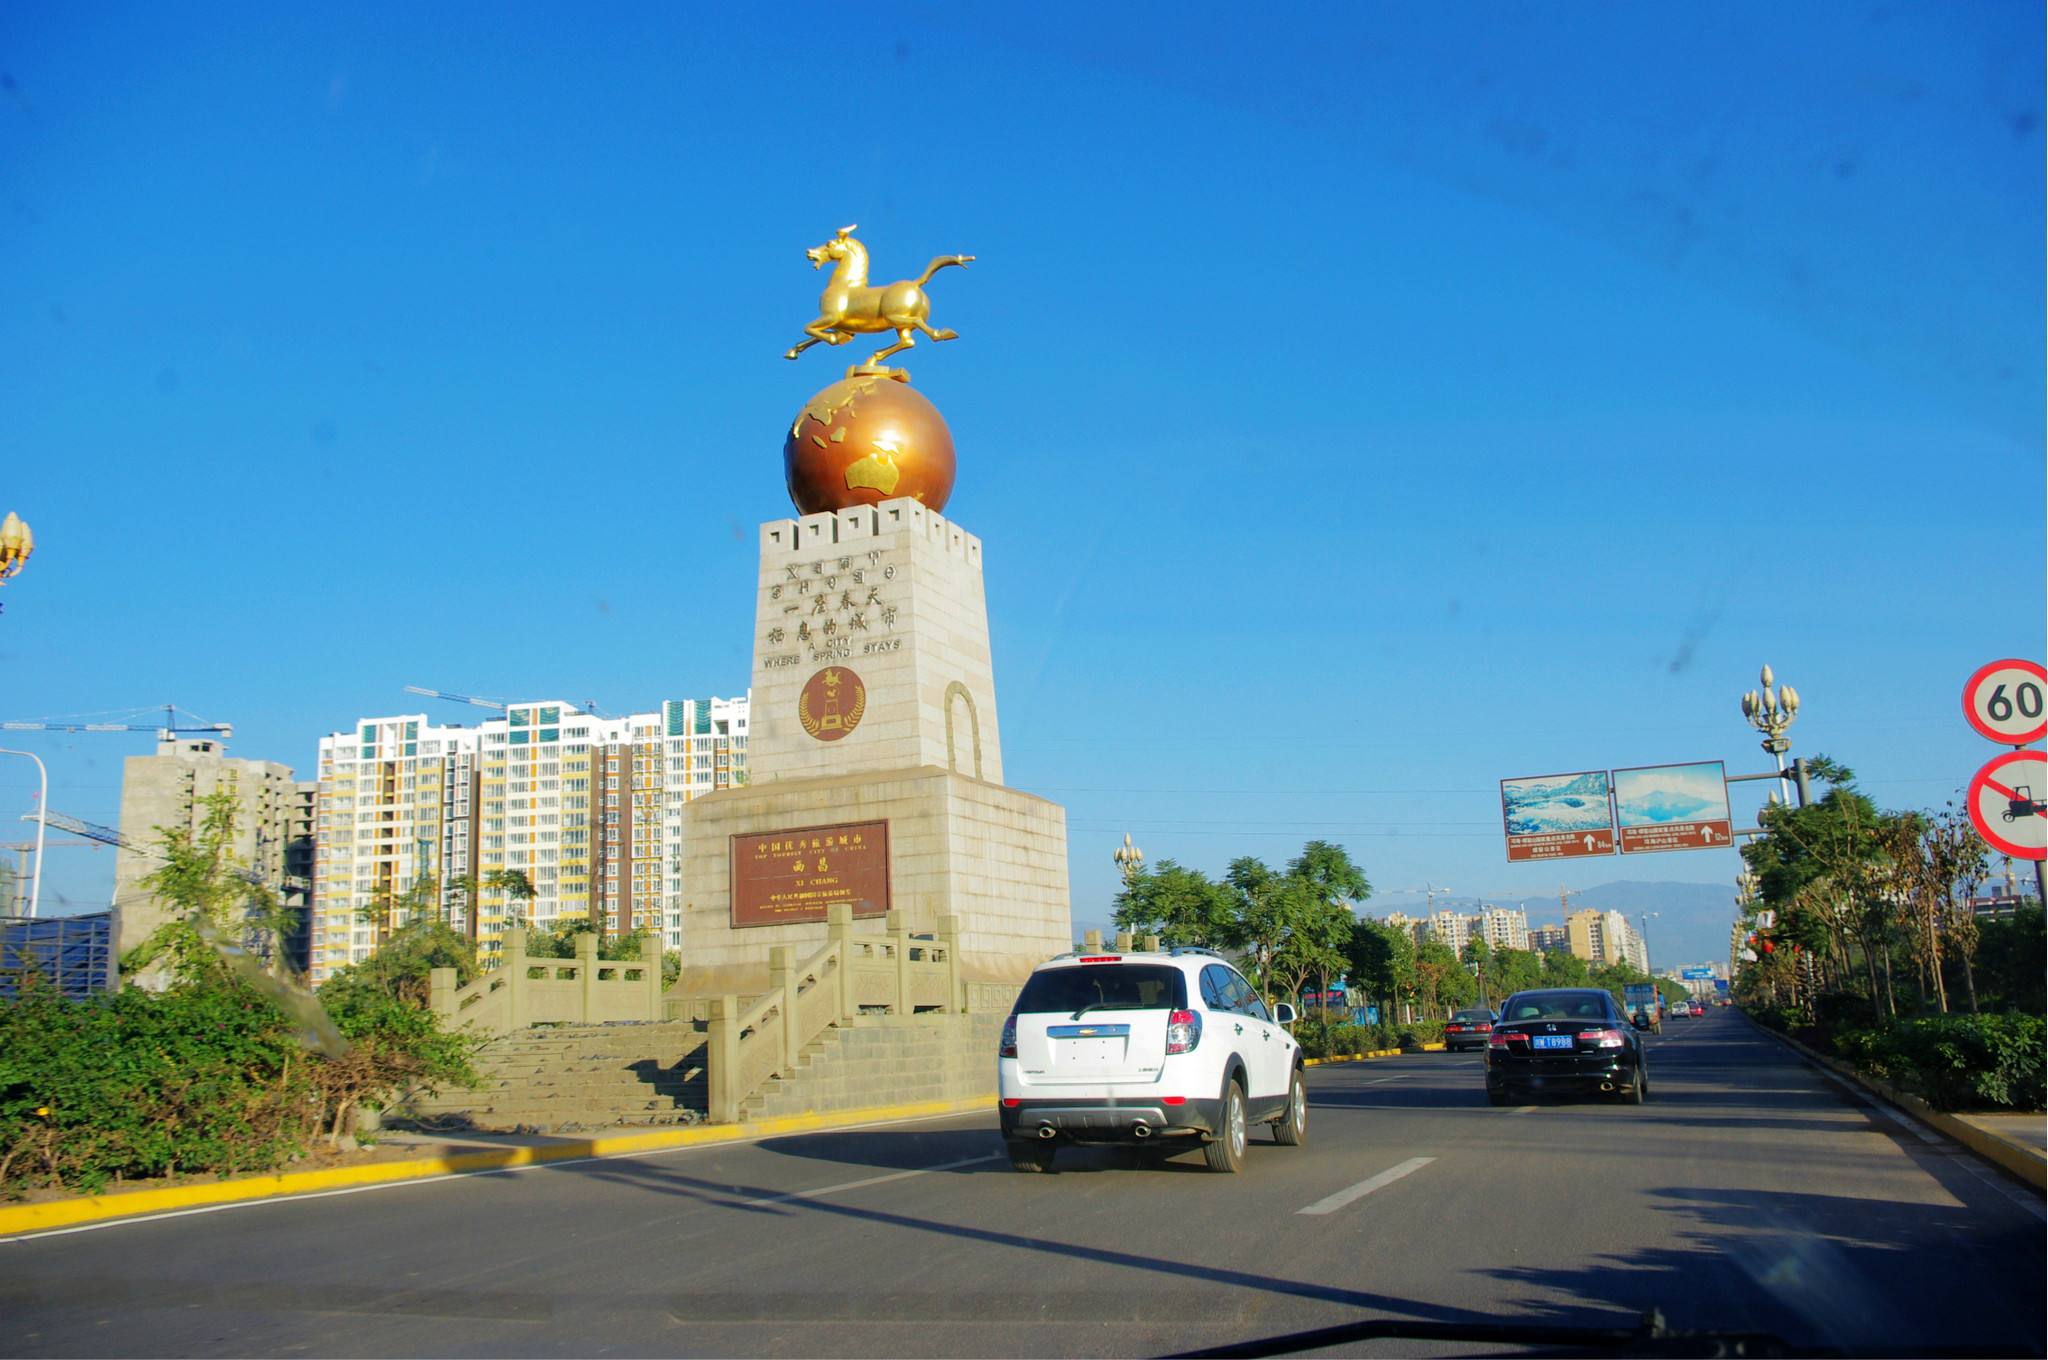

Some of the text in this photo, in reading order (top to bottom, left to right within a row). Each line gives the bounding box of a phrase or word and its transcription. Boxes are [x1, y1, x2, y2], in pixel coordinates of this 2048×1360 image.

[783, 586, 882, 617] 一座春天
[768, 607, 898, 645] 栖息的城市
[763, 639, 901, 669] WHERE SPRING STAYS
[808, 638, 852, 651] A CITY
[1987, 681, 2043, 722] 60
[809, 877, 839, 886] CHANG
